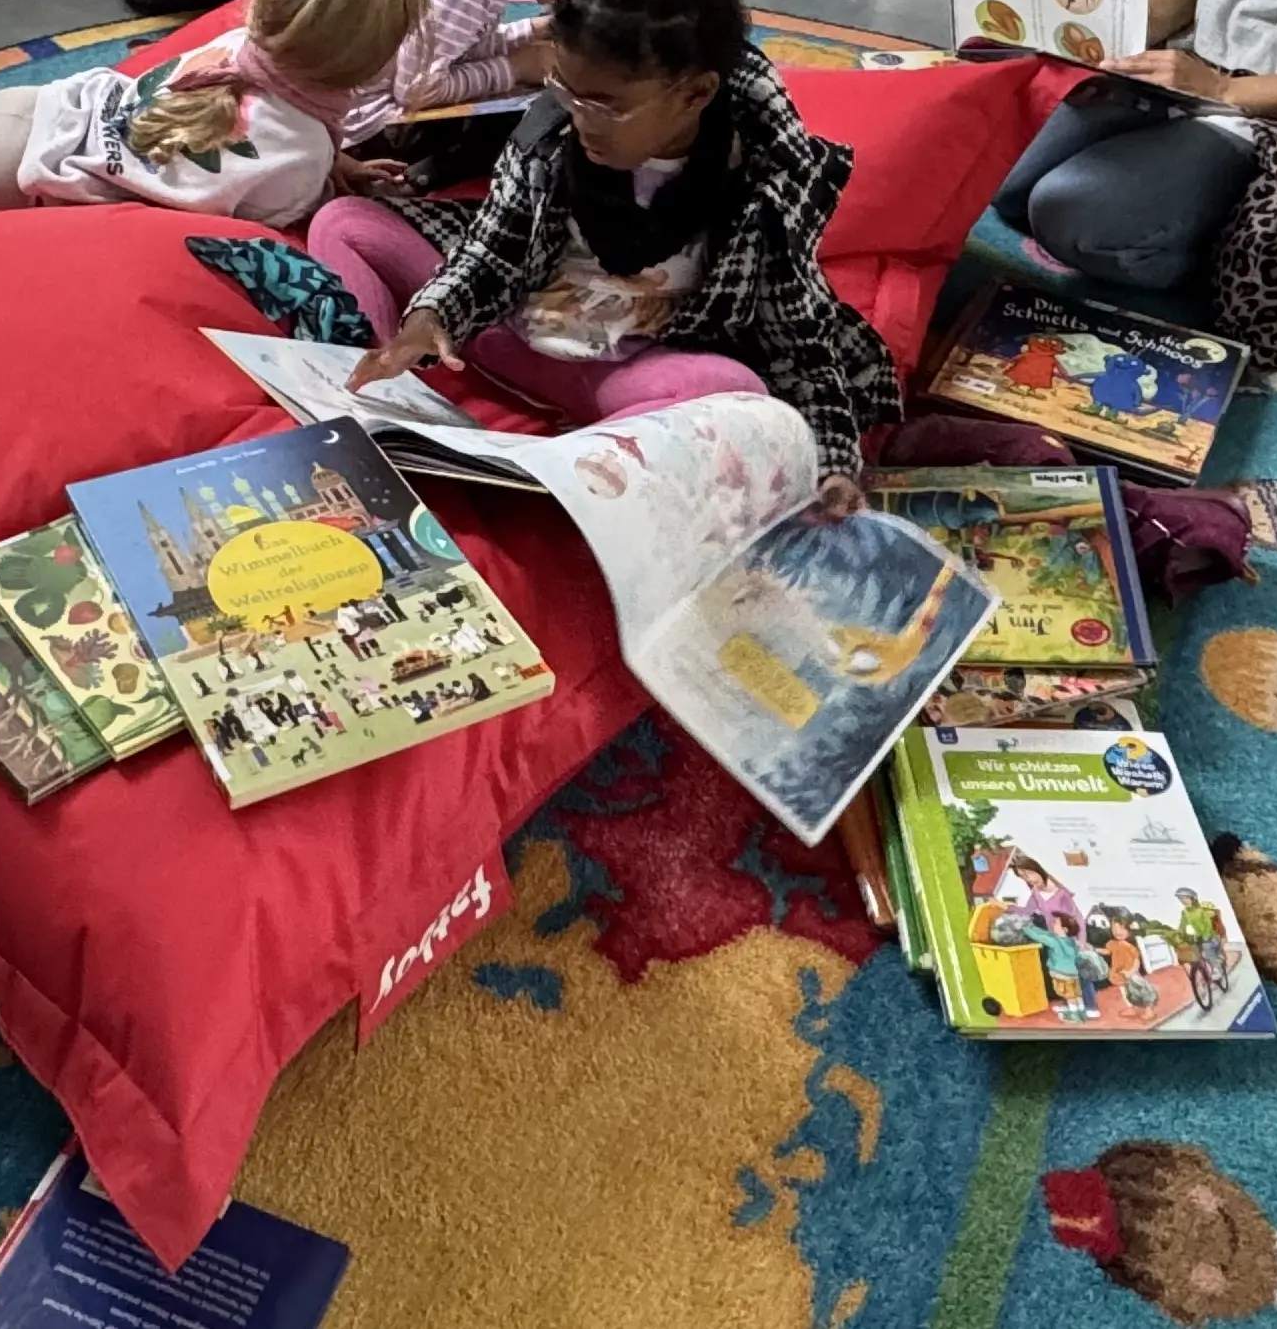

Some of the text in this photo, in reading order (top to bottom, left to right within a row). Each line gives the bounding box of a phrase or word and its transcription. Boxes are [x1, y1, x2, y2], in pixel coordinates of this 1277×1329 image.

[1033, 297, 1064, 314] Die
[1124, 330, 1203, 370] Schmoos
[218, 534, 344, 578] Wimmelbuch
[278, 564, 305, 579] der
[229, 561, 370, 608] Weltreligionen
[1009, 616, 1054, 637] Jim
[976, 757, 1082, 775] Wir schützen
[959, 772, 1110, 794] unsere Umwelt
[369, 863, 492, 1015] fatboy
